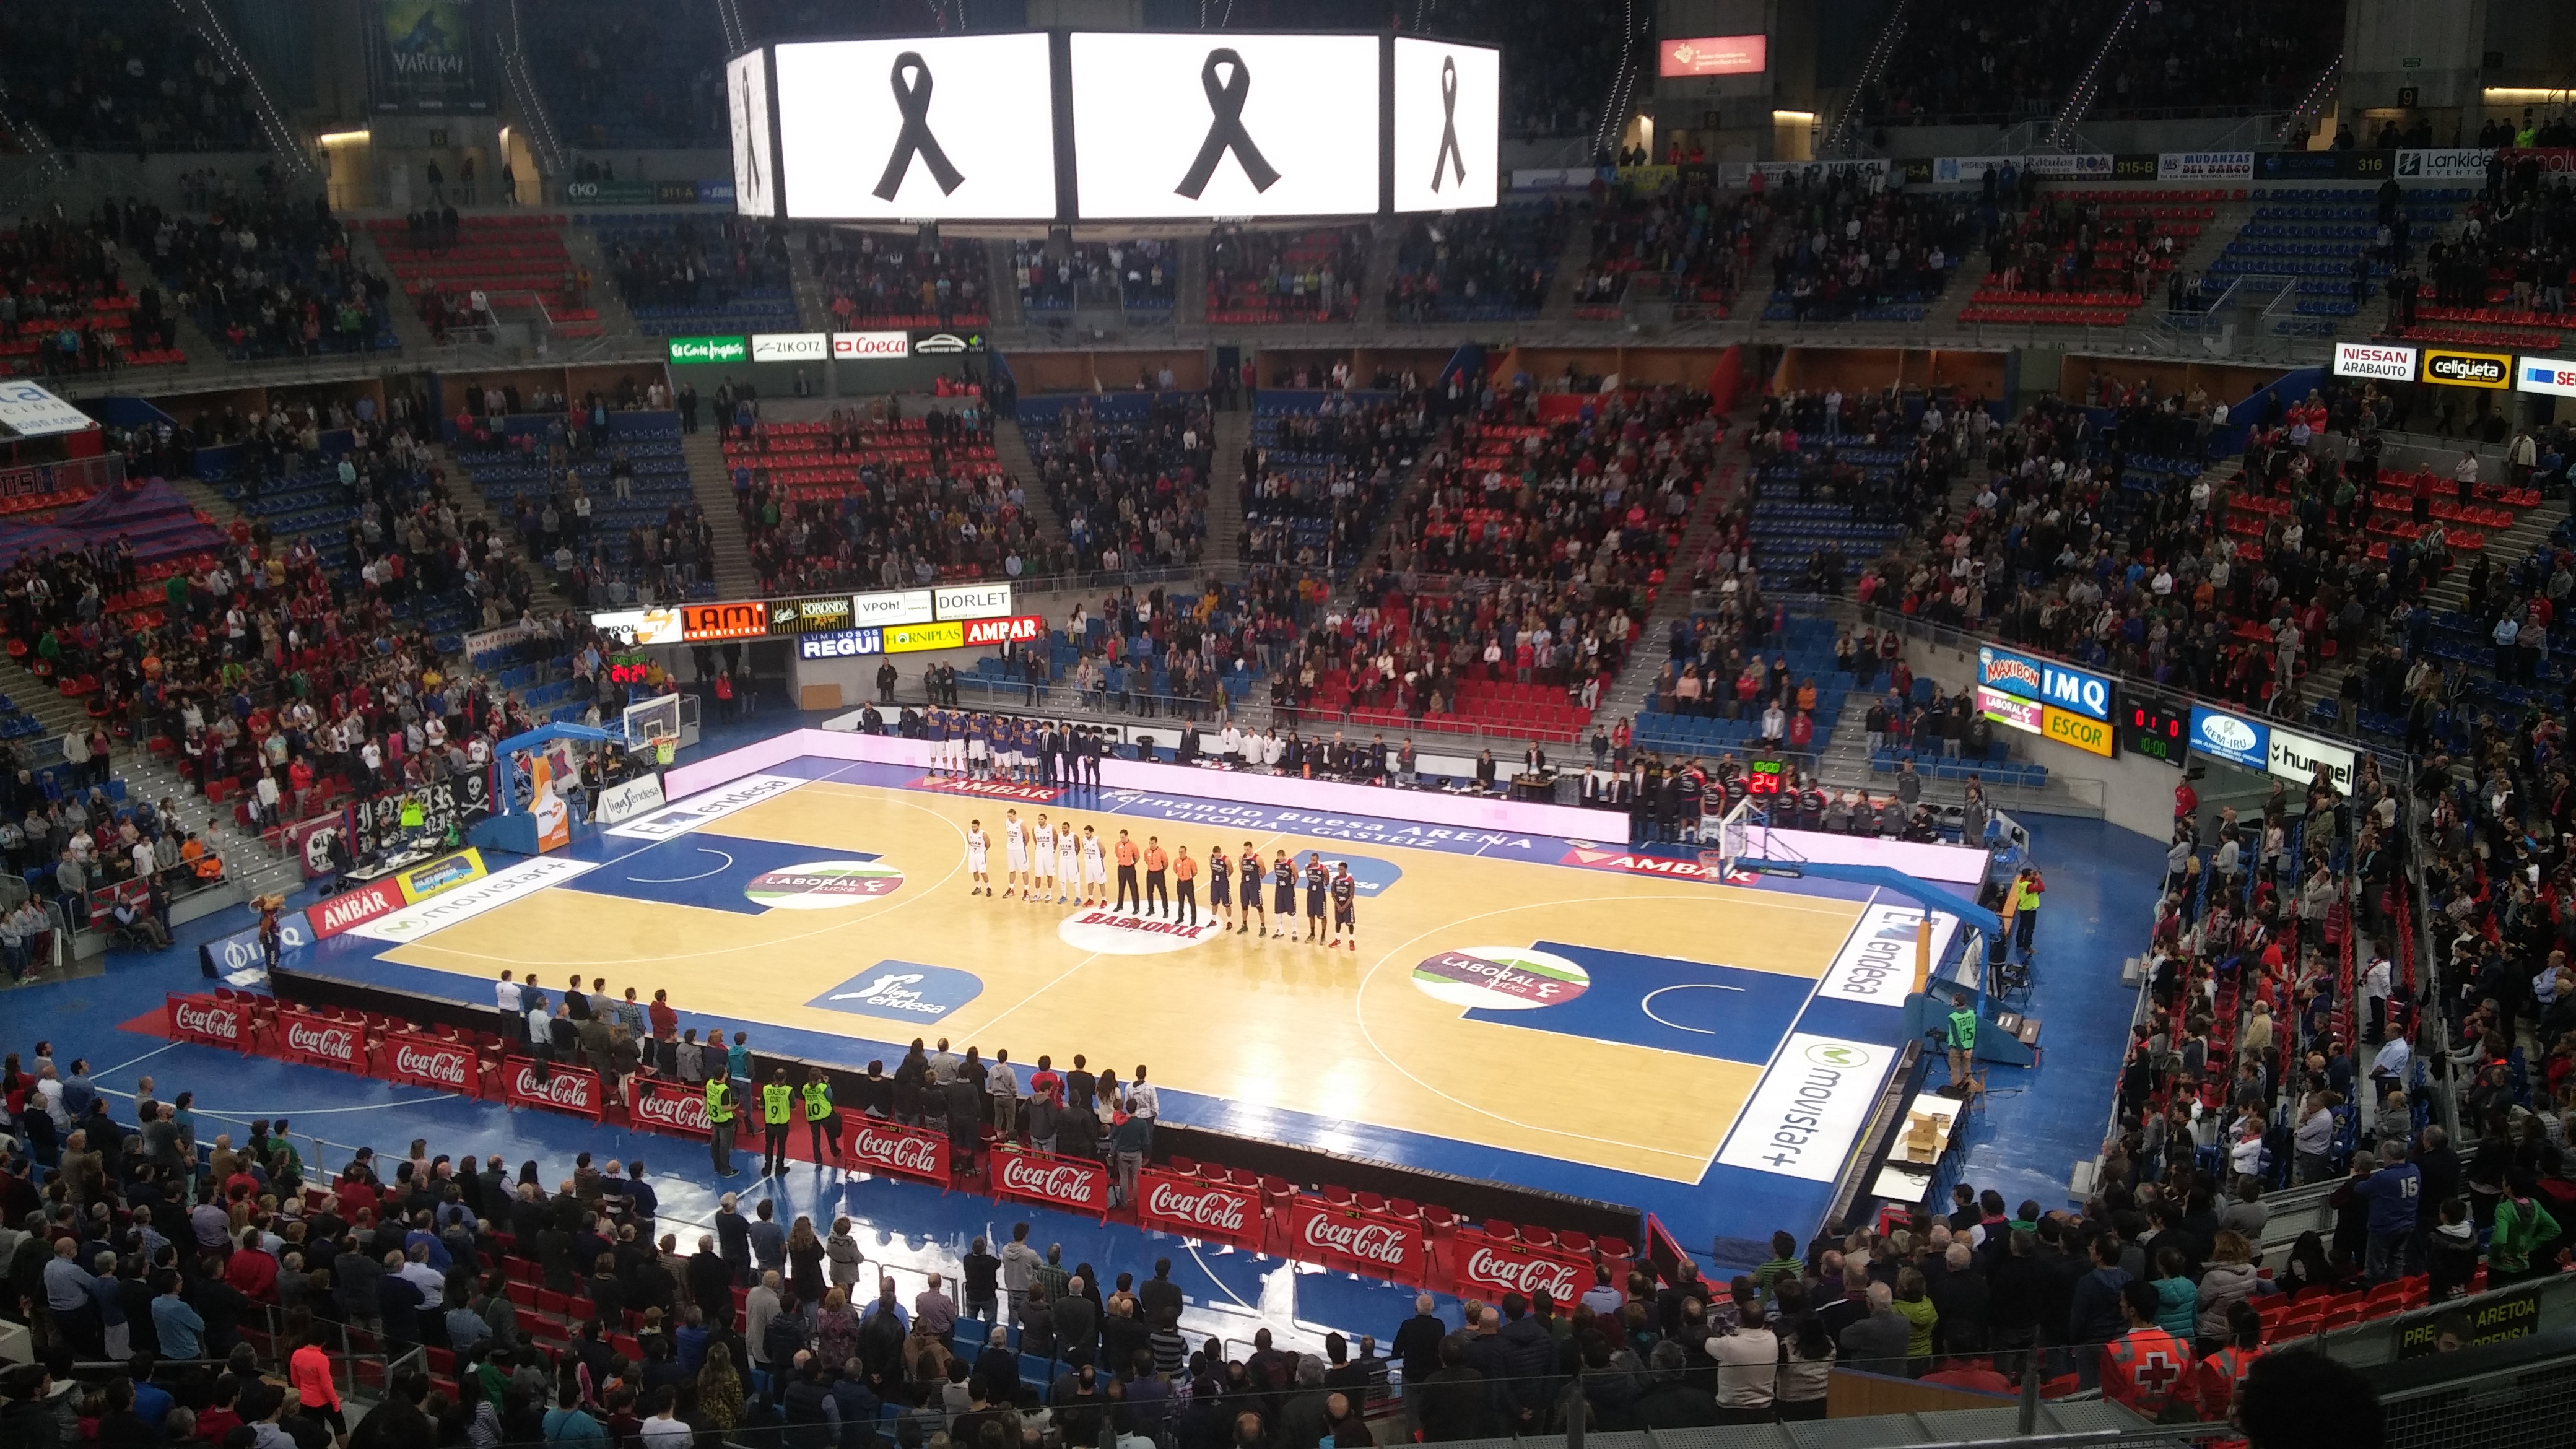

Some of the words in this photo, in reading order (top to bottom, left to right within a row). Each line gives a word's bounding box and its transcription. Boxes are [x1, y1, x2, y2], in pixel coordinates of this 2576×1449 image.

[2403, 90, 2413, 105] 9
[2117, 161, 2154, 174] 315-B
[2182, 165, 2203, 174] DEL
[2184, 154, 2250, 164] MUDANZAS
[2357, 159, 2383, 172] 316
[2427, 149, 2494, 168] Lankide
[775, 341, 821, 353] ZIKOTZ
[856, 337, 906, 354] Coeca
[2343, 347, 2408, 364] NISSAN
[2343, 361, 2406, 376] ARABAUTO
[2435, 358, 2499, 379] celigüeta
[2556, 371, 2576, 386] SE
[801, 600, 850, 614] FORONDA
[863, 601, 900, 612] VPOh!
[939, 592, 1008, 609] DORLET
[803, 629, 879, 642] LUMINOSOS
[886, 628, 960, 645] HORNIPLAS
[968, 619, 1036, 642] AMBAR
[803, 636, 881, 658] REGUI
[611, 664, 629, 682] 24
[631, 664, 646, 682] 24
[1986, 659, 2040, 689] MAXIBON
[2043, 668, 2107, 716] IMQ
[1986, 695, 2022, 715] LABORAL
[2052, 714, 2103, 747] ESCOR
[2136, 709, 2144, 727] 0
[2151, 716, 2156, 729] 1
[2169, 720, 2178, 738] 0
[2141, 736, 2167, 758] 10:00
[2204, 724, 2247, 749] REM-IRU
[1752, 760, 1781, 773] 10:00
[942, 780, 1055, 799] AMBAR
[1750, 772, 1780, 794] 24
[630, 785, 659, 804] endesa
[697, 780, 790, 813] endesa
[1098, 791, 1264, 817] Fernando
[1274, 811, 1385, 832] Buesa
[1396, 825, 1533, 849] ARENA
[1163, 809, 1278, 830] VITORIA
[1310, 827, 1440, 848] GASTEIZ
[1606, 856, 1752, 882] AMBAR
[422, 862, 566, 918] movistar+
[765, 876, 860, 887] LABORAL
[328, 887, 375, 909] CERVEZAS
[324, 890, 389, 930] AMBAR
[1441, 956, 1534, 987] LABORAL
[1842, 941, 1902, 994] endesa
[881, 982, 923, 999] liga
[866, 995, 947, 1014] endesa
[176, 1003, 238, 1039] Coca-Cola
[288, 1022, 354, 1060] Coca-Cola
[1962, 1027, 1974, 1042] 15
[396, 1045, 466, 1084] Coca-Cola
[516, 1067, 589, 1108] Coca-Cola
[638, 1090, 715, 1131] Coca-Cola
[770, 1105, 778, 1119] 9
[807, 1103, 820, 1117] 10
[1762, 1068, 1842, 1167] movistar+
[855, 1128, 937, 1172] Coca-Cola
[1003, 1156, 1094, 1203] Coca-Cola
[2400, 1177, 2420, 1200] 15
[1149, 1183, 1247, 1230] Coca-Cola
[1305, 1213, 1408, 1264] Coca-Cola
[1468, 1247, 1578, 1302] Coca-Cola
[2476, 1297, 2536, 1329] ARETOA
